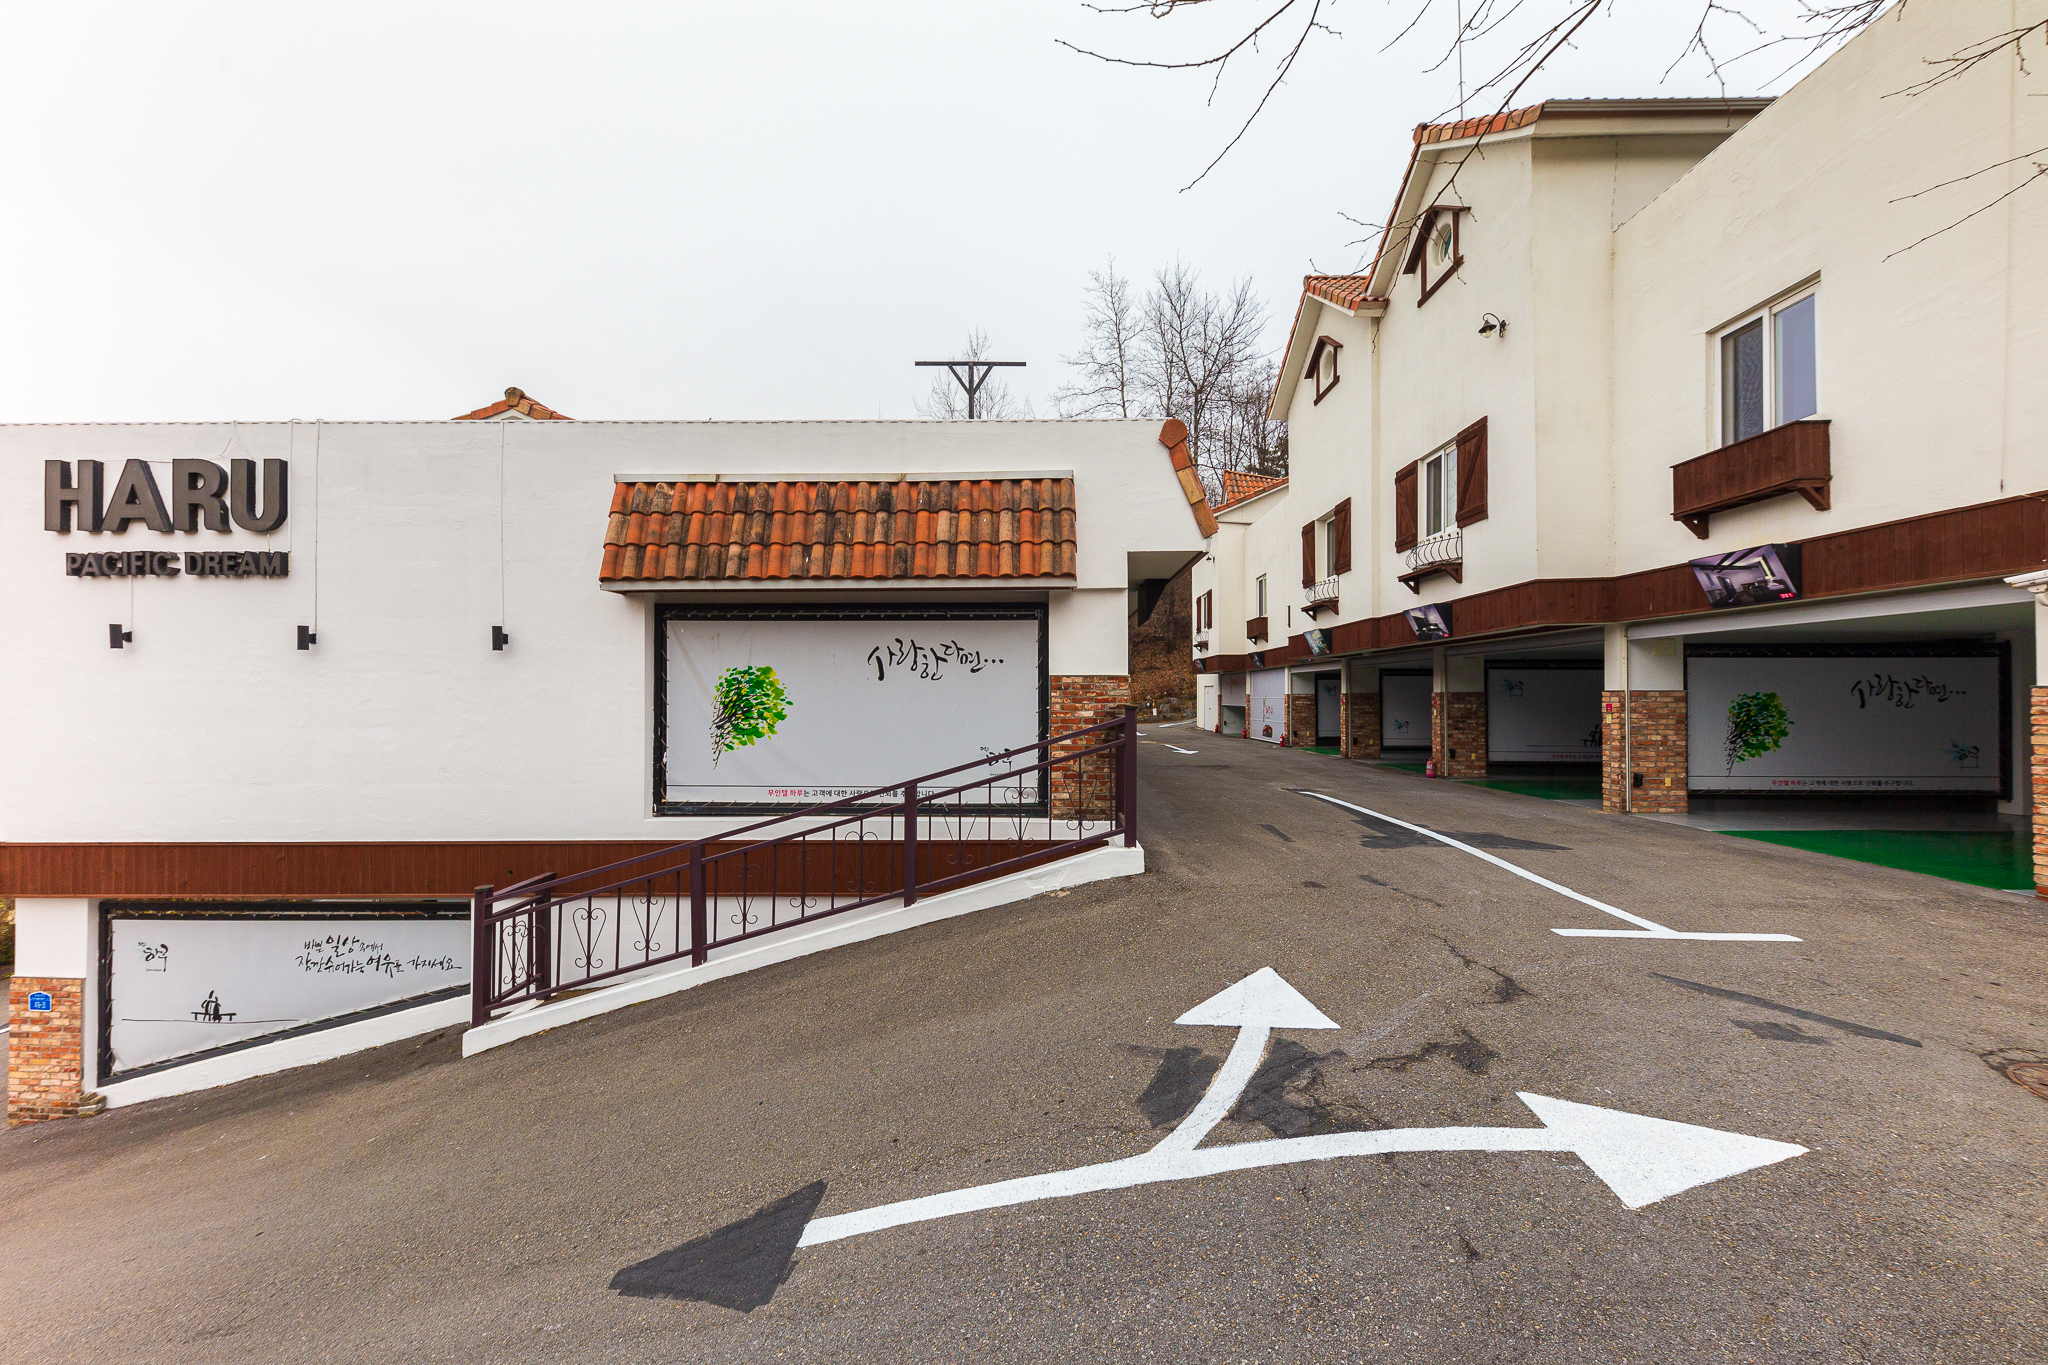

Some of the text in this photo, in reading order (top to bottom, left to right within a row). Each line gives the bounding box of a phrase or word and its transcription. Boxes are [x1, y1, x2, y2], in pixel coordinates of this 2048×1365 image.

[44, 459, 288, 533] HARU
[66, 551, 290, 577] PACIFIC DREAM
[767, 789, 788, 798] 무인텔
[790, 789, 810, 798] 하루는
[811, 789, 832, 798] 고객에
[834, 789, 848, 798] 대한
[304, 939, 324, 953] 바쁜
[325, 934, 360, 958] 일상
[406, 955, 463, 971] 가지세요
